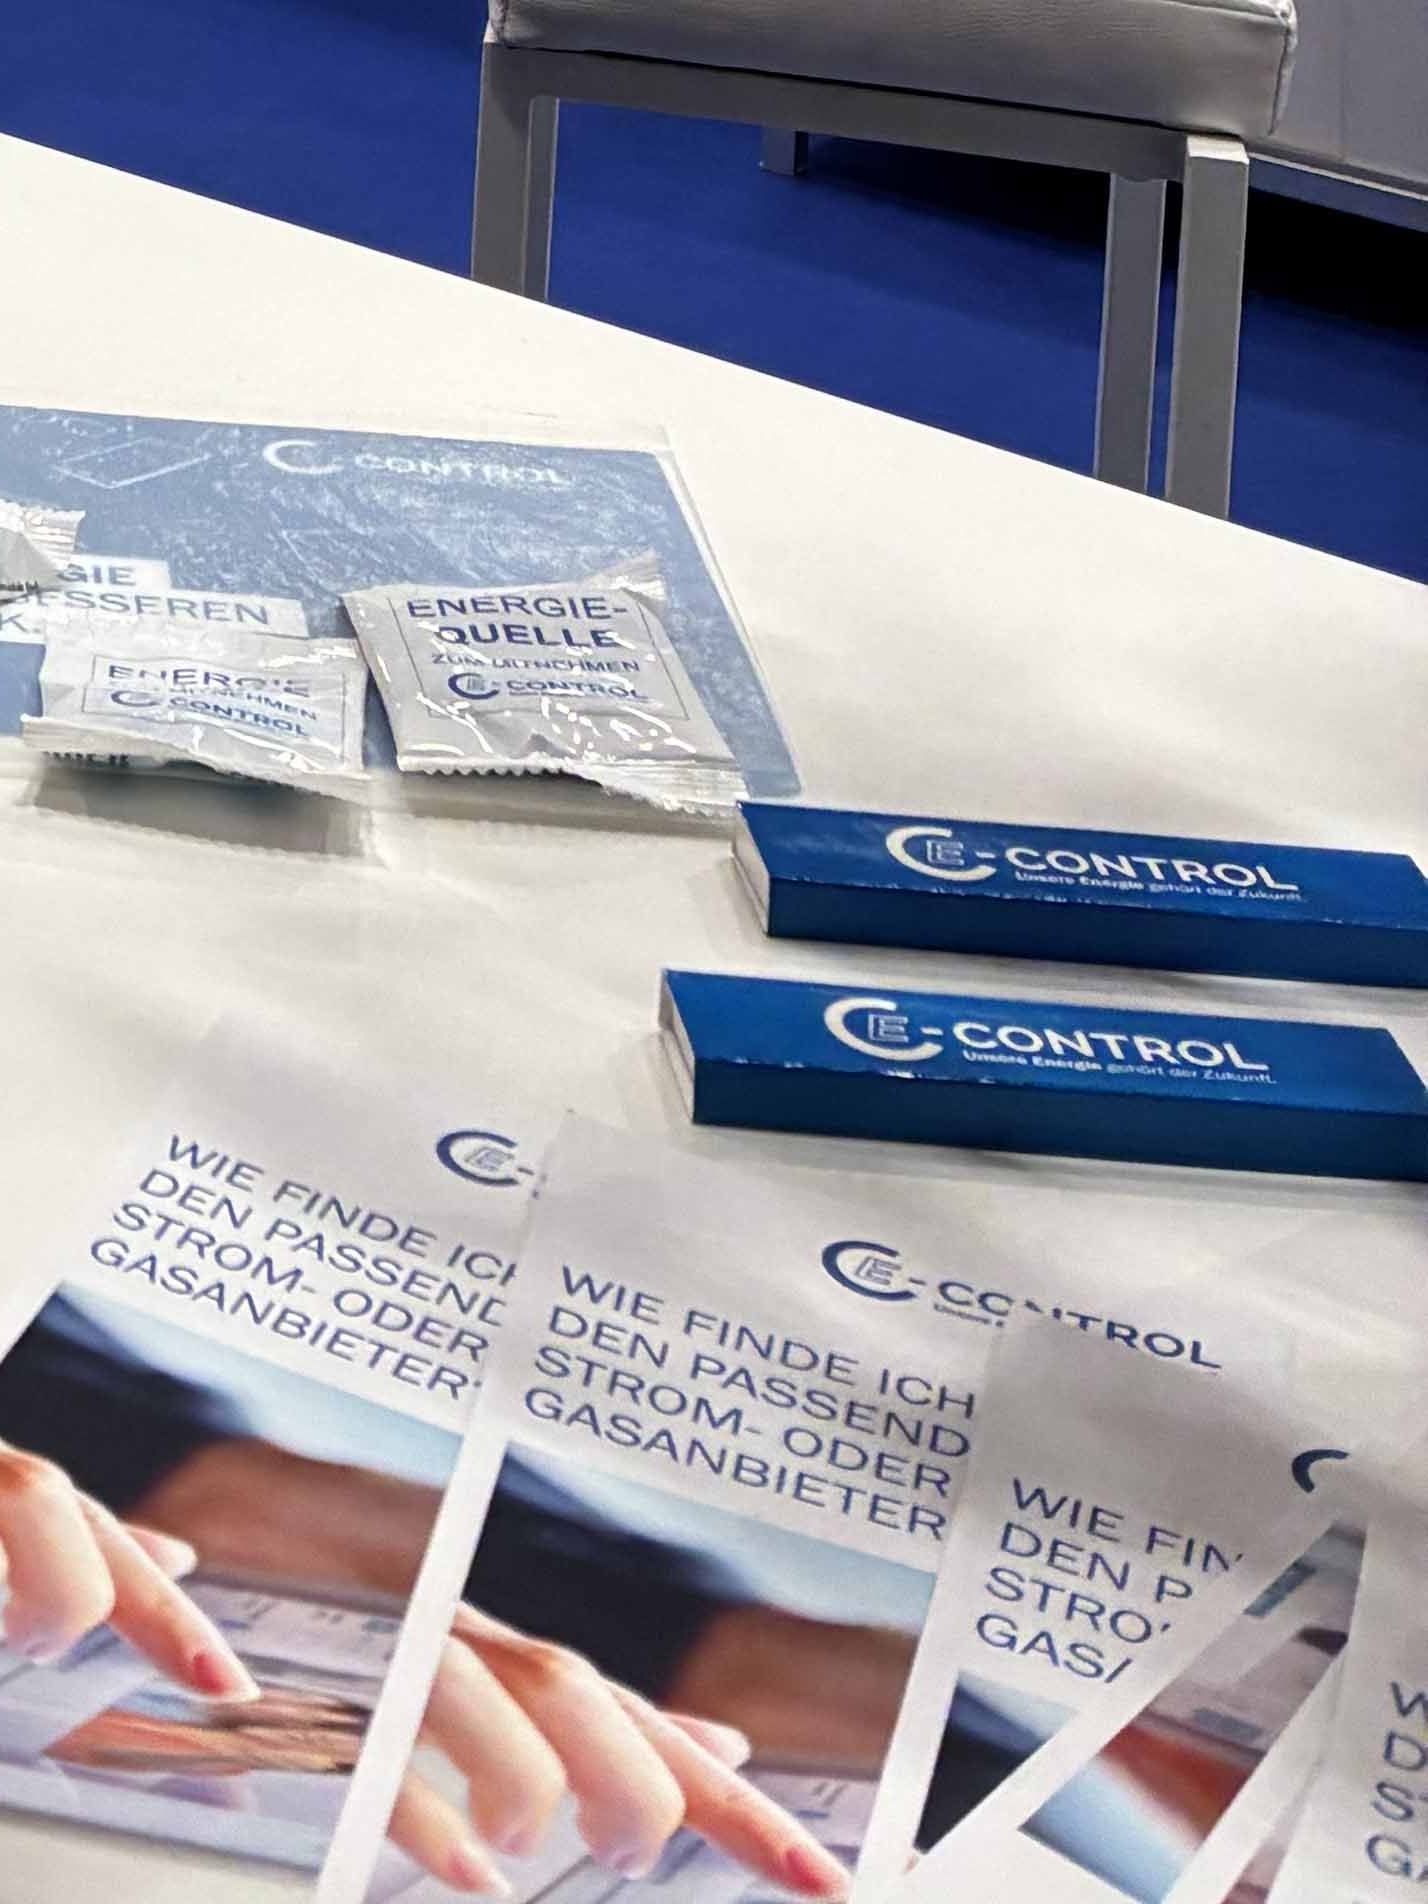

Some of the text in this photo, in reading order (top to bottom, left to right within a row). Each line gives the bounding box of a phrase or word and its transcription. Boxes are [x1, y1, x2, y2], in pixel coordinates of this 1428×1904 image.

[407, 595, 629, 621] ENERGIE-
[435, 622, 622, 649] QUELLE
[885, 824, 1301, 893] E-CONTROL
[822, 996, 1270, 1072] E-CONTROL
[139, 1169, 253, 1230] DEN
[169, 1134, 438, 1258] WIE FINDE
[89, 1237, 483, 1400] GASANBIETER
[113, 1202, 490, 1363] STROM- ODER
[548, 1305, 971, 1459] DEN PASSEND
[561, 1264, 976, 1420] WIE FINDE ICH
[524, 1387, 948, 1542] GASANBIETER
[534, 1346, 952, 1499] STROM- ODER
[999, 1521, 1129, 1592] DEN
[1010, 1477, 1125, 1542] WIE
